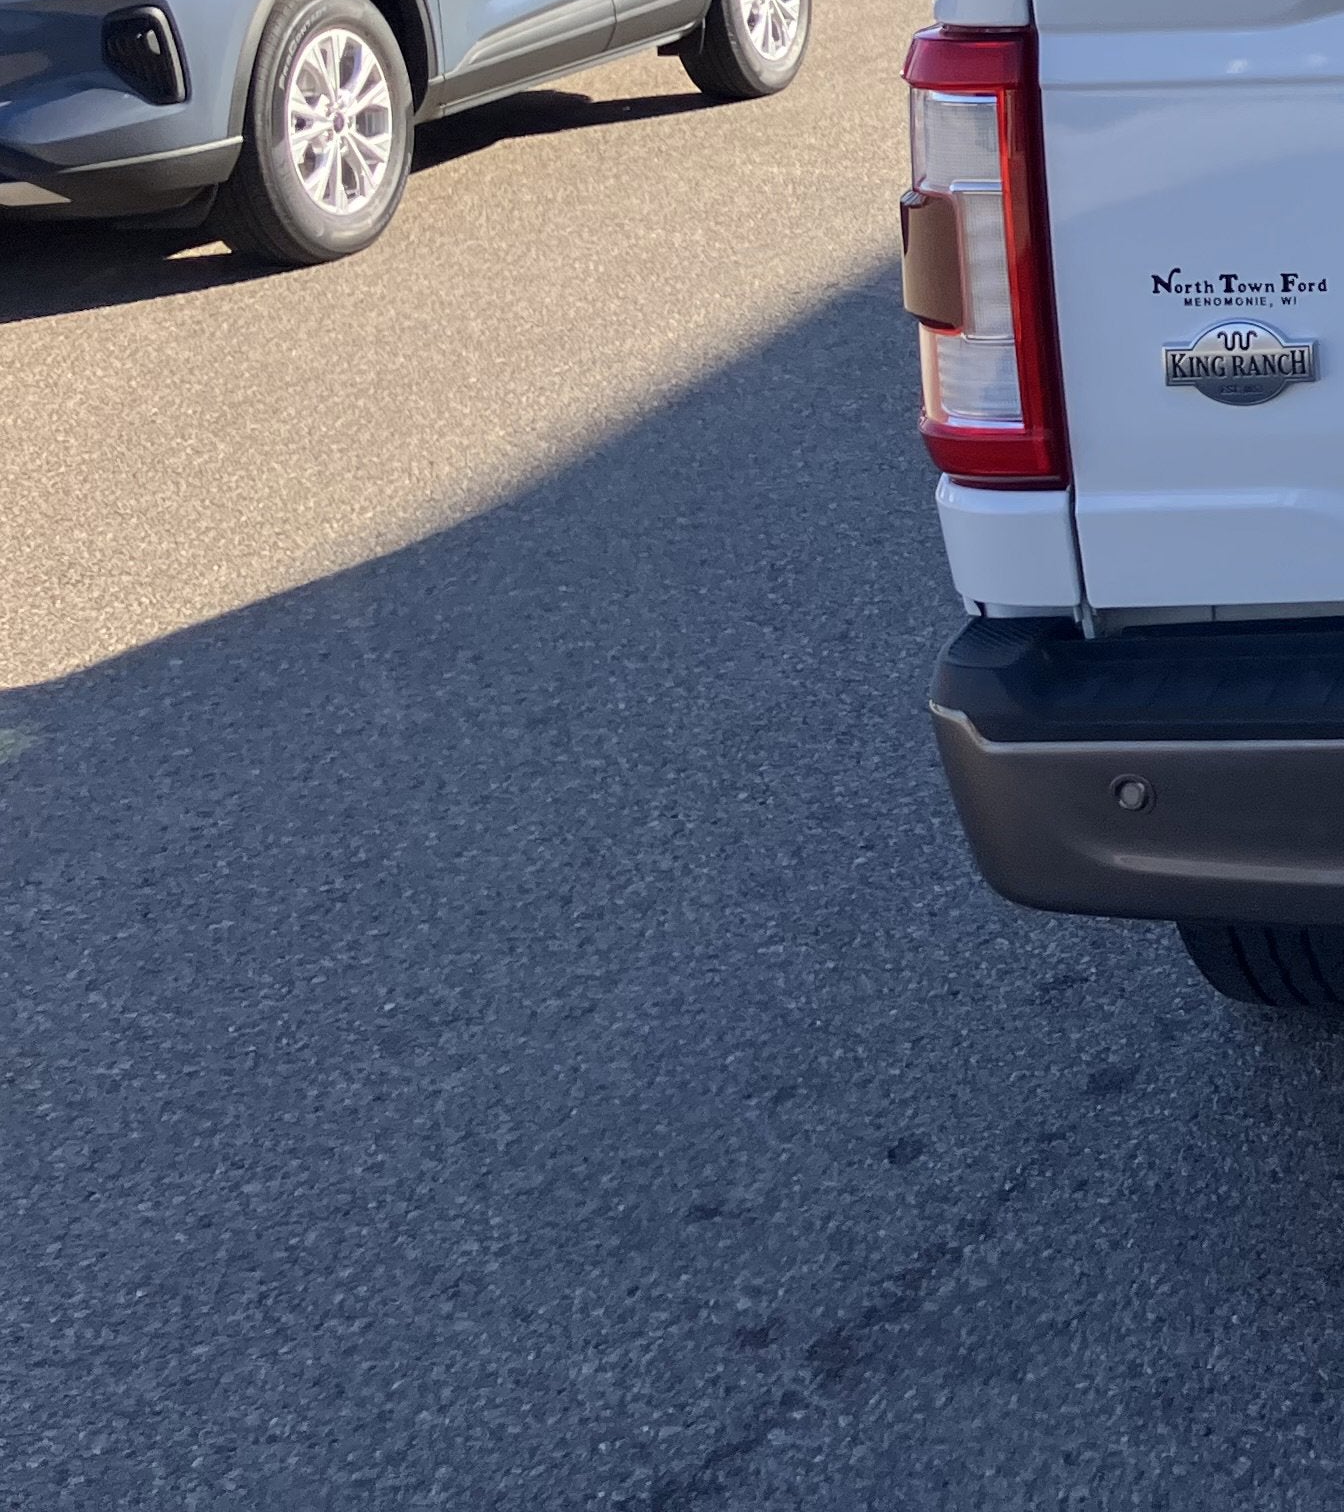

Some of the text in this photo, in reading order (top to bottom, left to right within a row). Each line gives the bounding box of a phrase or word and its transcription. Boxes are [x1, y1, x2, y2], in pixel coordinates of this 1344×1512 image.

[1151, 267, 1328, 294] North Town Ford
[1184, 296, 1297, 308] MENOMONIE, WI
[1171, 349, 1307, 378] KING RANCH
